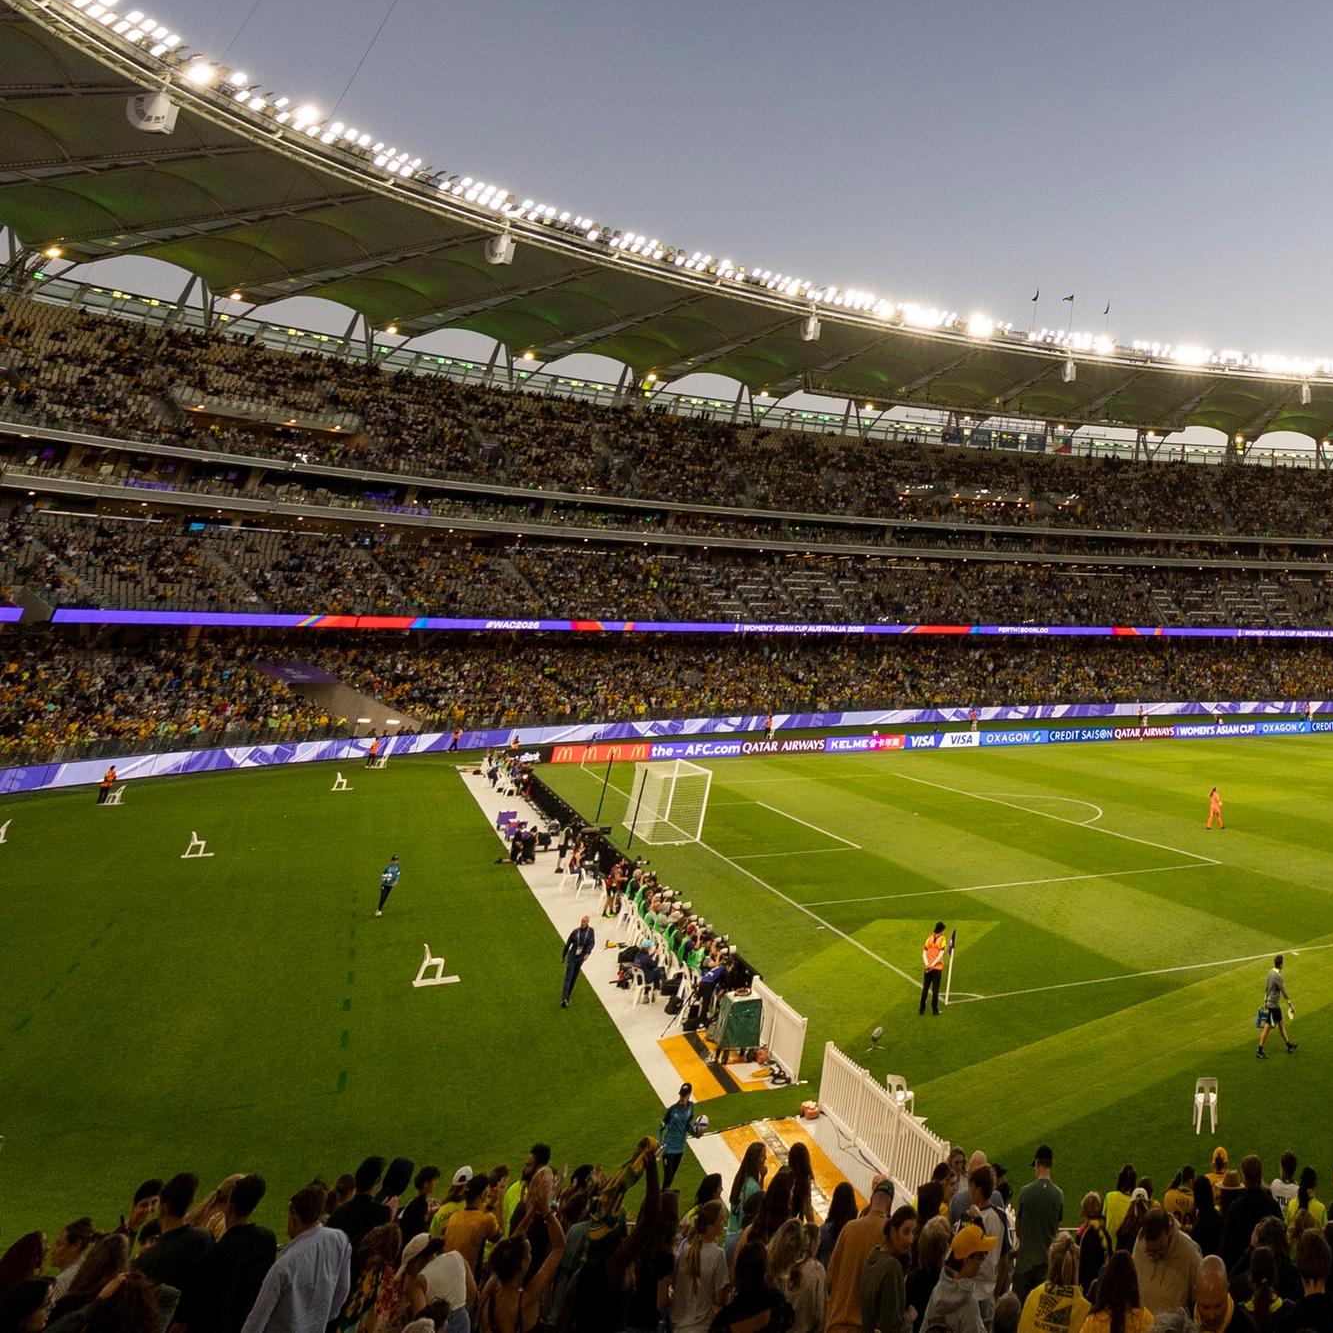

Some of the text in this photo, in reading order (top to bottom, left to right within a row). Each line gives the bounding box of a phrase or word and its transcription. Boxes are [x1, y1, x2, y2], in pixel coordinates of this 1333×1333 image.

[1114, 727, 1175, 739] QATAR AIRWAYS
[1180, 724, 1256, 736] WOMEN'S ASIAN CUP
[1262, 723, 1297, 733] OXAGON
[910, 735, 935, 747] VISA
[951, 734, 973, 745] VISA
[985, 732, 1030, 743] OXAGON
[1049, 729, 1113, 741] CREDIT SAISON
[652, 745, 673, 757] the
[685, 743, 741, 756] AFC.com
[742, 739, 825, 754] QATAR AIRWAYS
[830, 739, 869, 749] KELME
